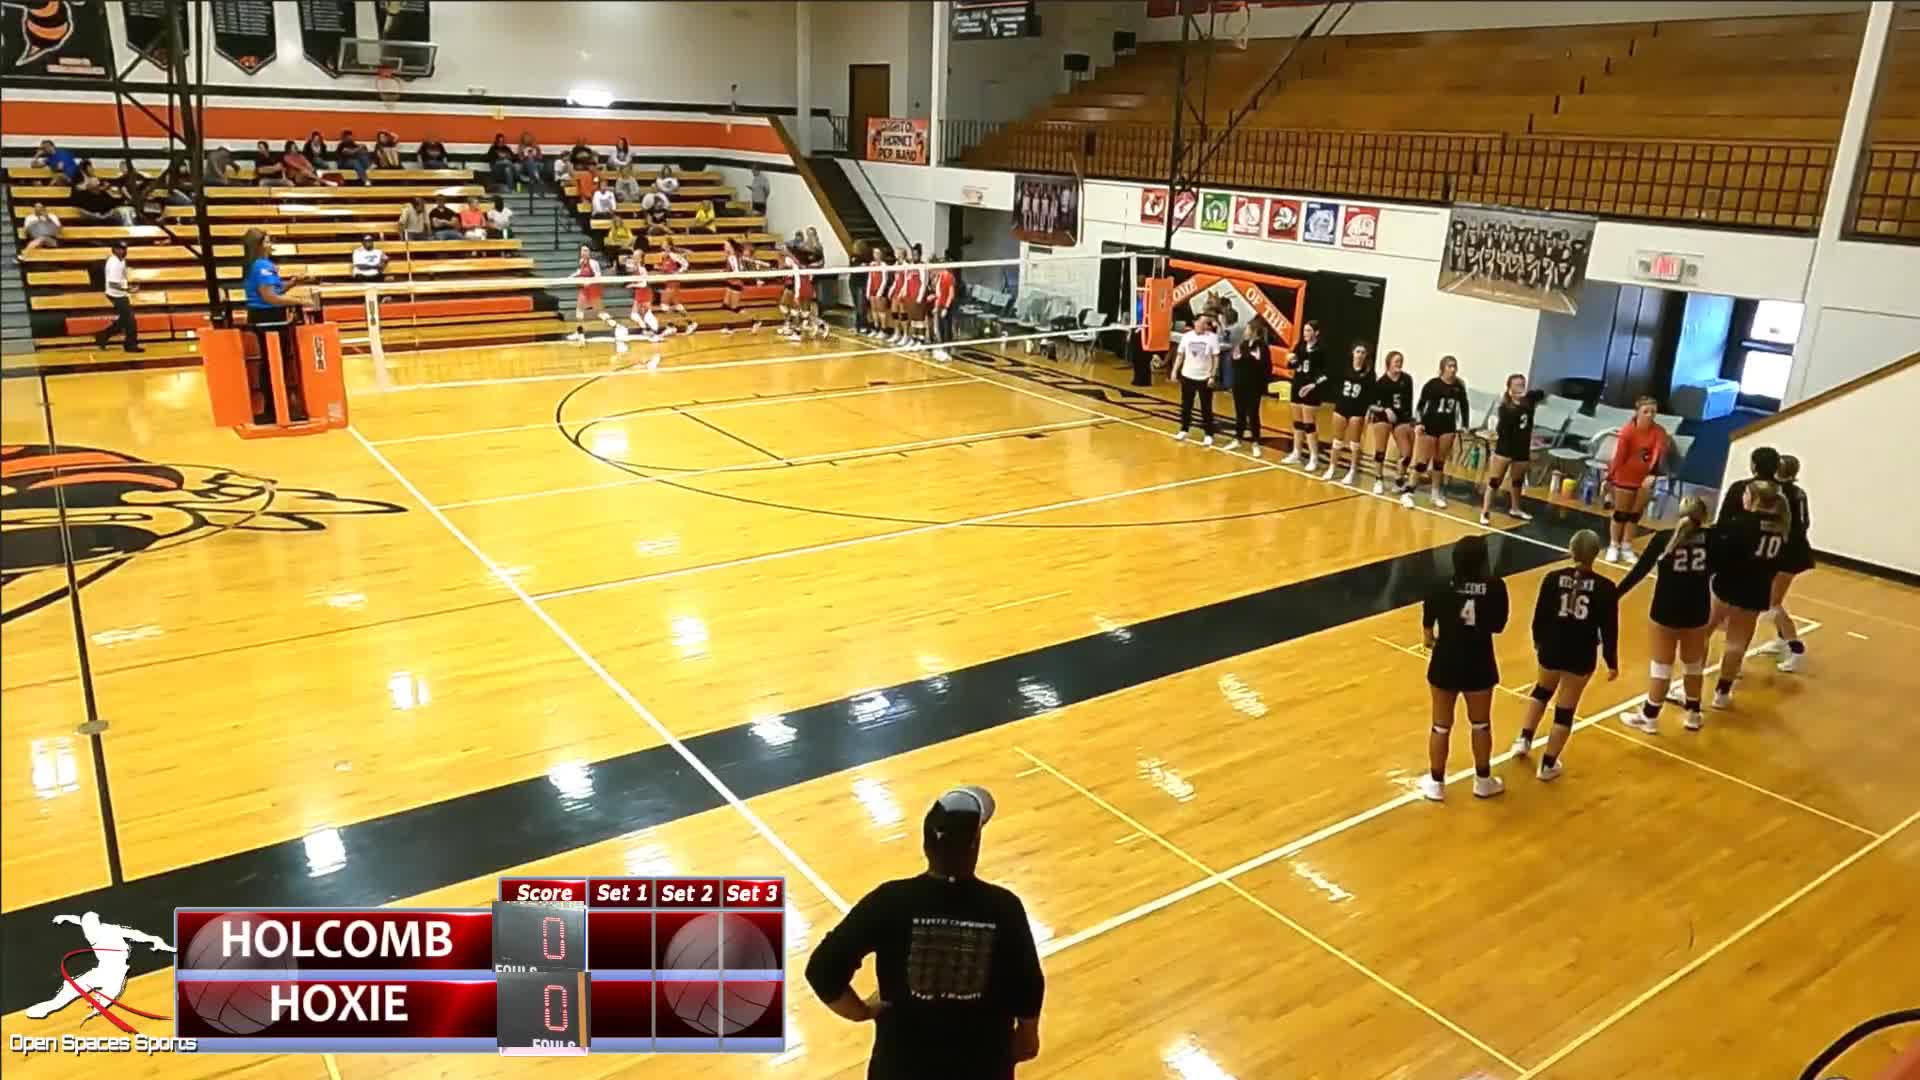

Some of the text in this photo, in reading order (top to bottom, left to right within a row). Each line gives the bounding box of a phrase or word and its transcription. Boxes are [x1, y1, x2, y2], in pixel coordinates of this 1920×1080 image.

[1172, 278, 1198, 303] OME
[1245, 287, 1290, 336] OF THE
[1343, 381, 1361, 398] 29
[1437, 397, 1455, 413] 13
[1673, 547, 1707, 572] 22
[1755, 535, 1782, 559] 10
[1460, 598, 1476, 627] 4
[1558, 592, 1590, 620] 16
